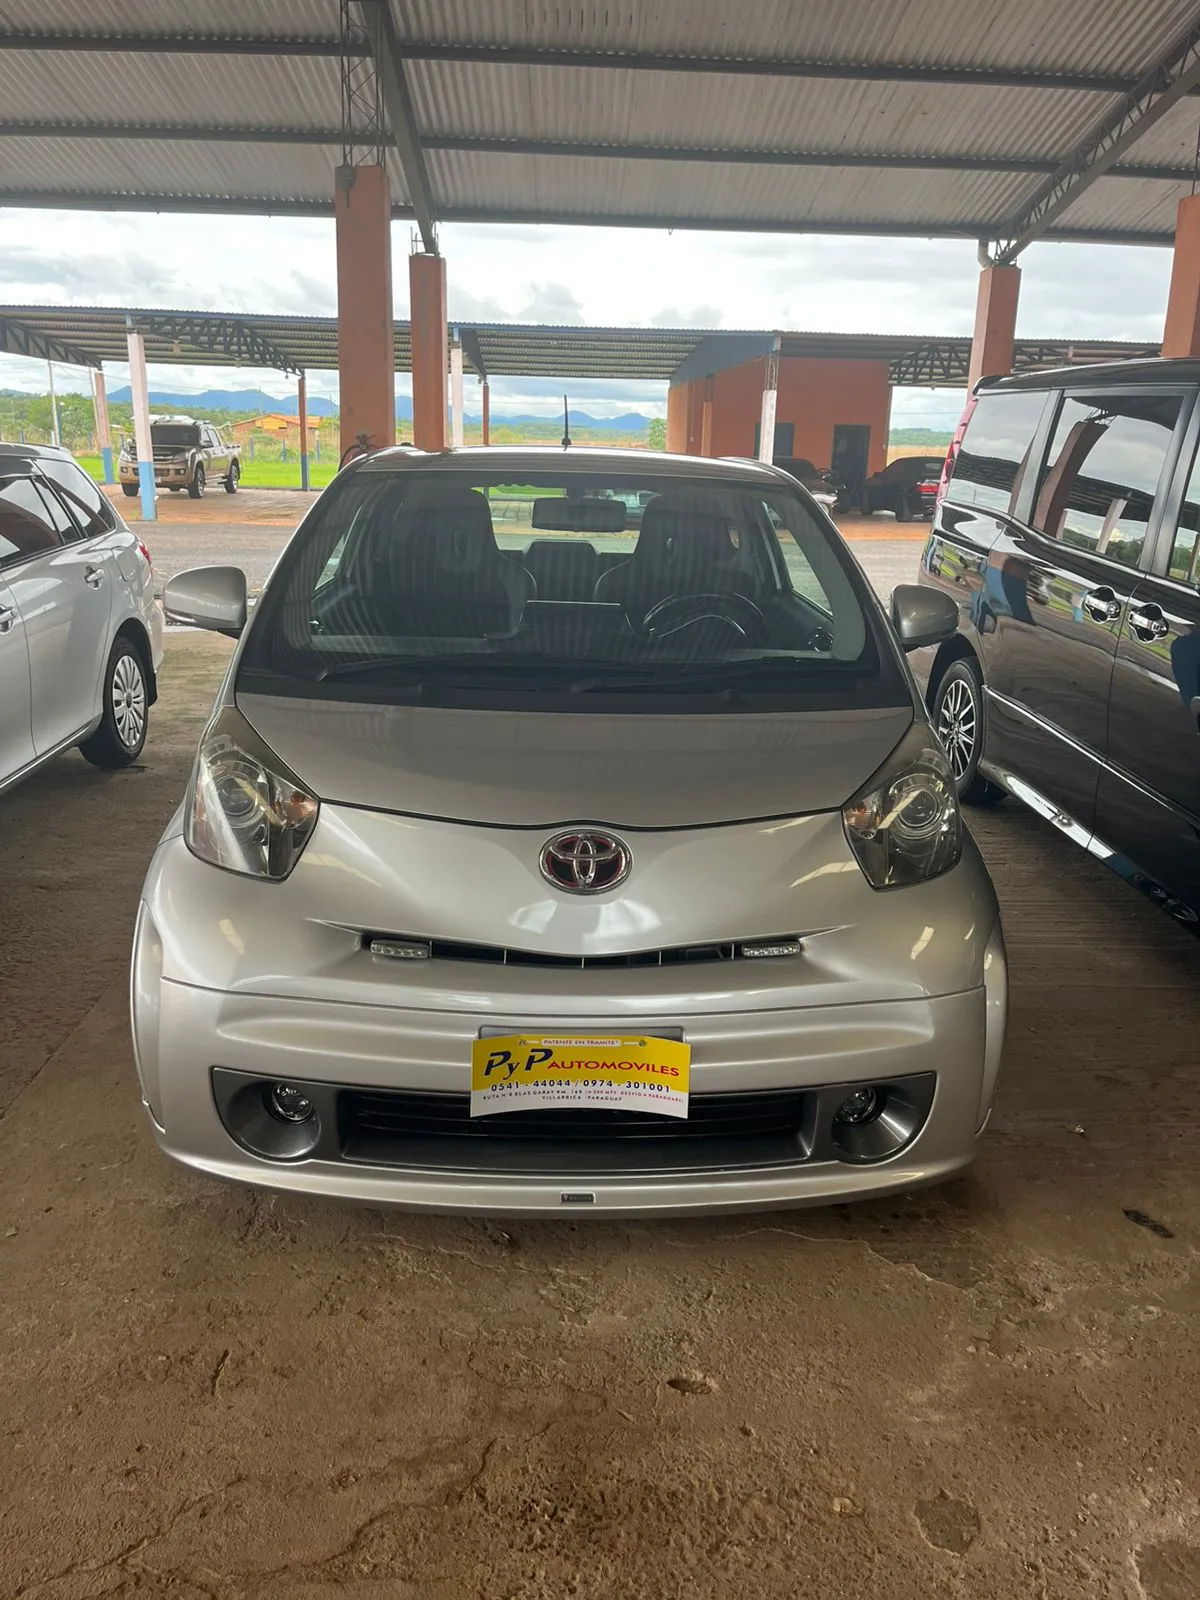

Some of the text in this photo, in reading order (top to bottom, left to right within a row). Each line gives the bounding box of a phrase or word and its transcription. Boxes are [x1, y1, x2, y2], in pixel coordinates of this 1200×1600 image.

[547, 1061, 680, 1077] AUTOMOVILES
[491, 1081, 519, 1092] 0541
[533, 1080, 571, 1088] 44044
[583, 1080, 613, 1088] 0974
[625, 1080, 670, 1093] 301001
